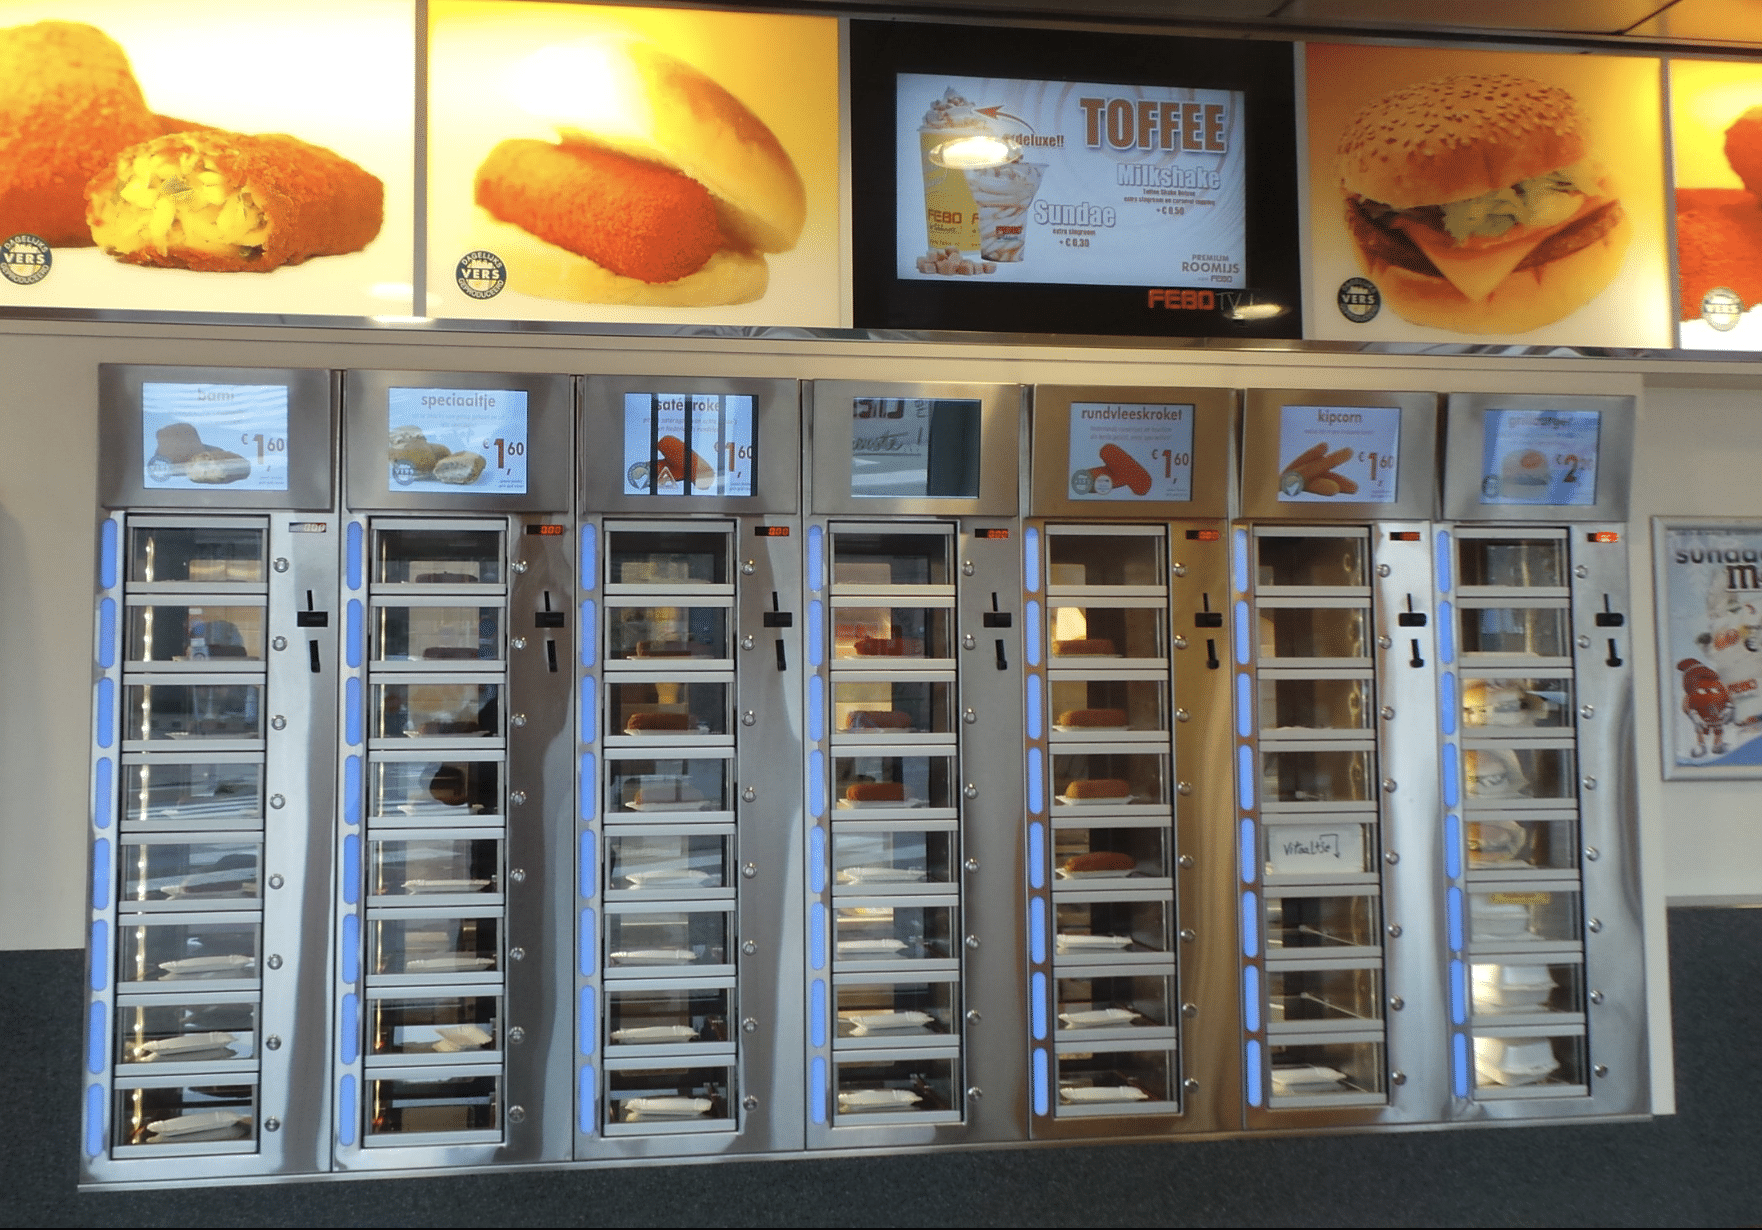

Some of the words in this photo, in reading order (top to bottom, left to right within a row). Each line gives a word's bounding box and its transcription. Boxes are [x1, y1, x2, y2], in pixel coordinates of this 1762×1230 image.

[1079, 97, 1228, 153] TOFFEE
[1117, 162, 1221, 190] Milkshake
[1033, 198, 1116, 228] Sundae
[3, 252, 46, 265] VERS
[1192, 254, 1229, 262] PREMIUM
[461, 268, 500, 280] VERS
[1182, 262, 1240, 274] ROOMIJS
[1148, 289, 1215, 310] FEBO
[1341, 294, 1375, 304] VERS
[421, 392, 496, 411] speciaaltje
[1081, 406, 1182, 420] rundvleeskroket
[1318, 408, 1362, 425] kipcorn
